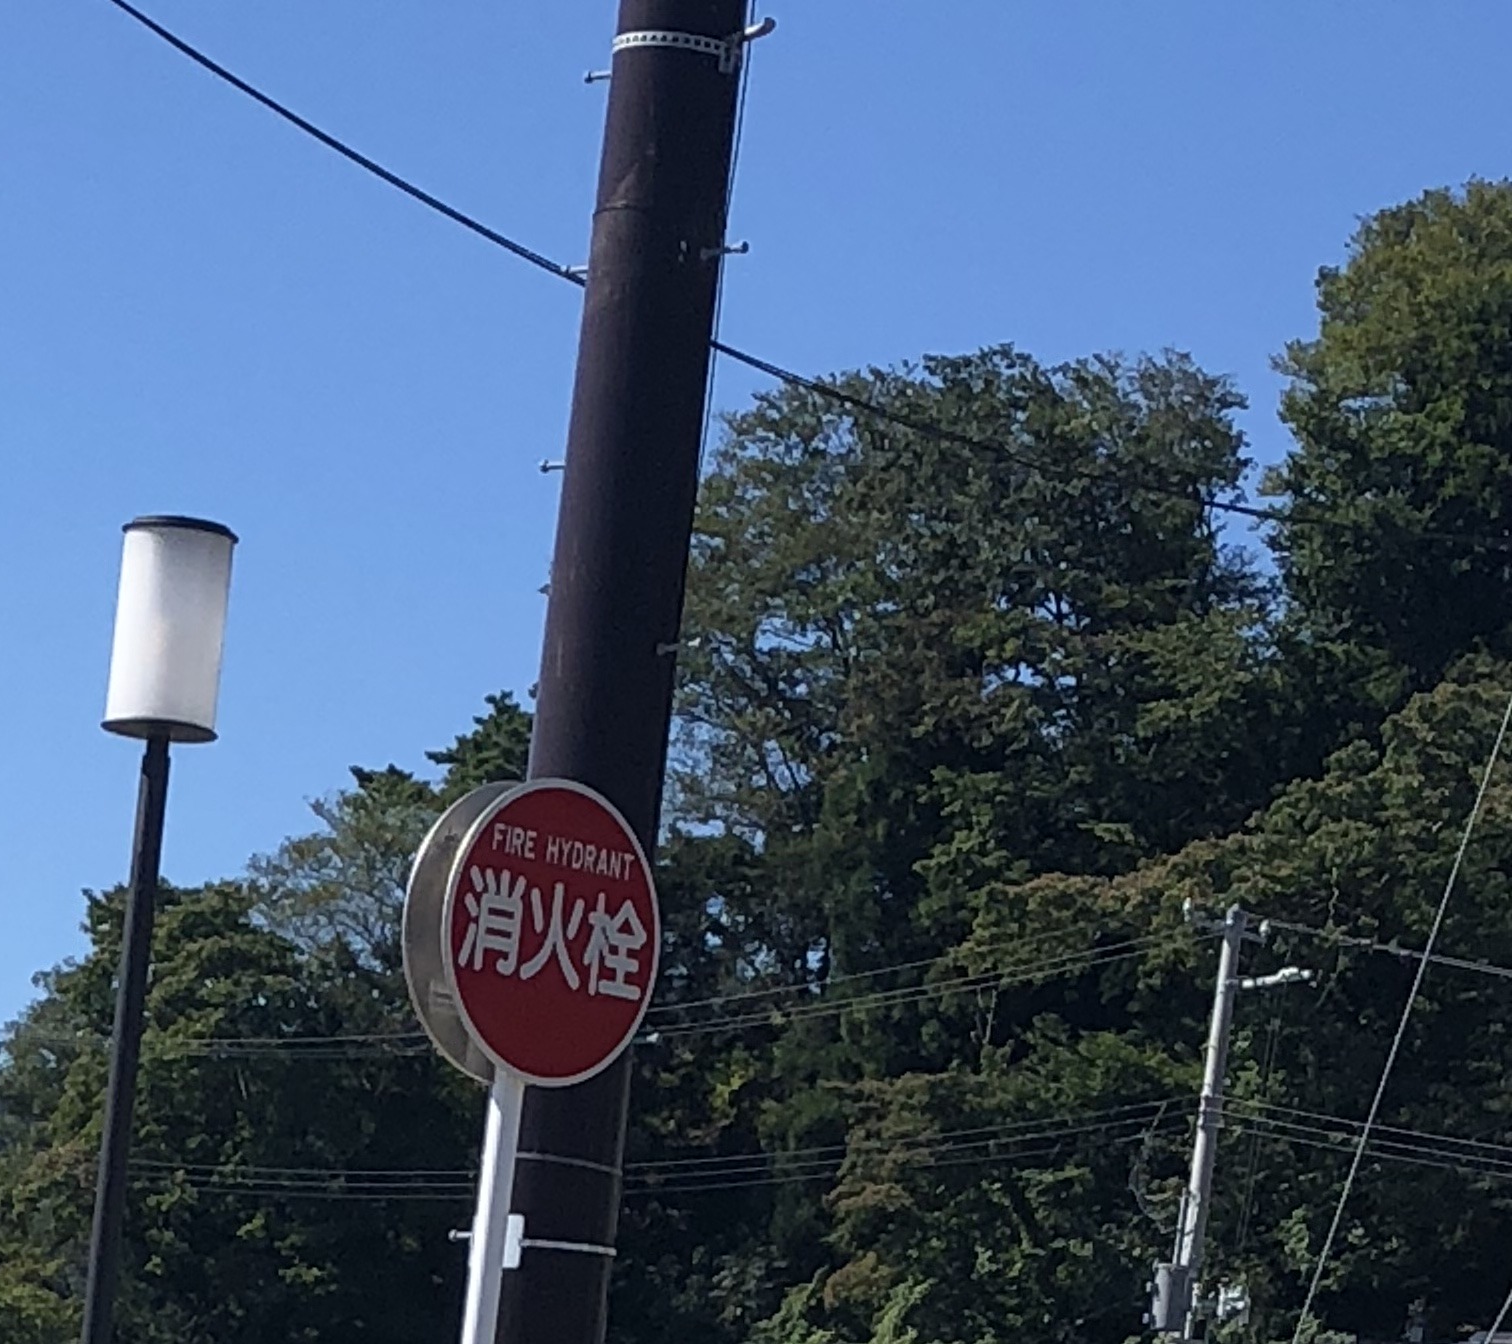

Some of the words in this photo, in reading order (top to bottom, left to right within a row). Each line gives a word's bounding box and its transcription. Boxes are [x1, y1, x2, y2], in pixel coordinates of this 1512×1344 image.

[492, 822, 537, 860] FIRE
[546, 836, 635, 880] HYDRANT
[458, 865, 647, 1001] 消火栓
